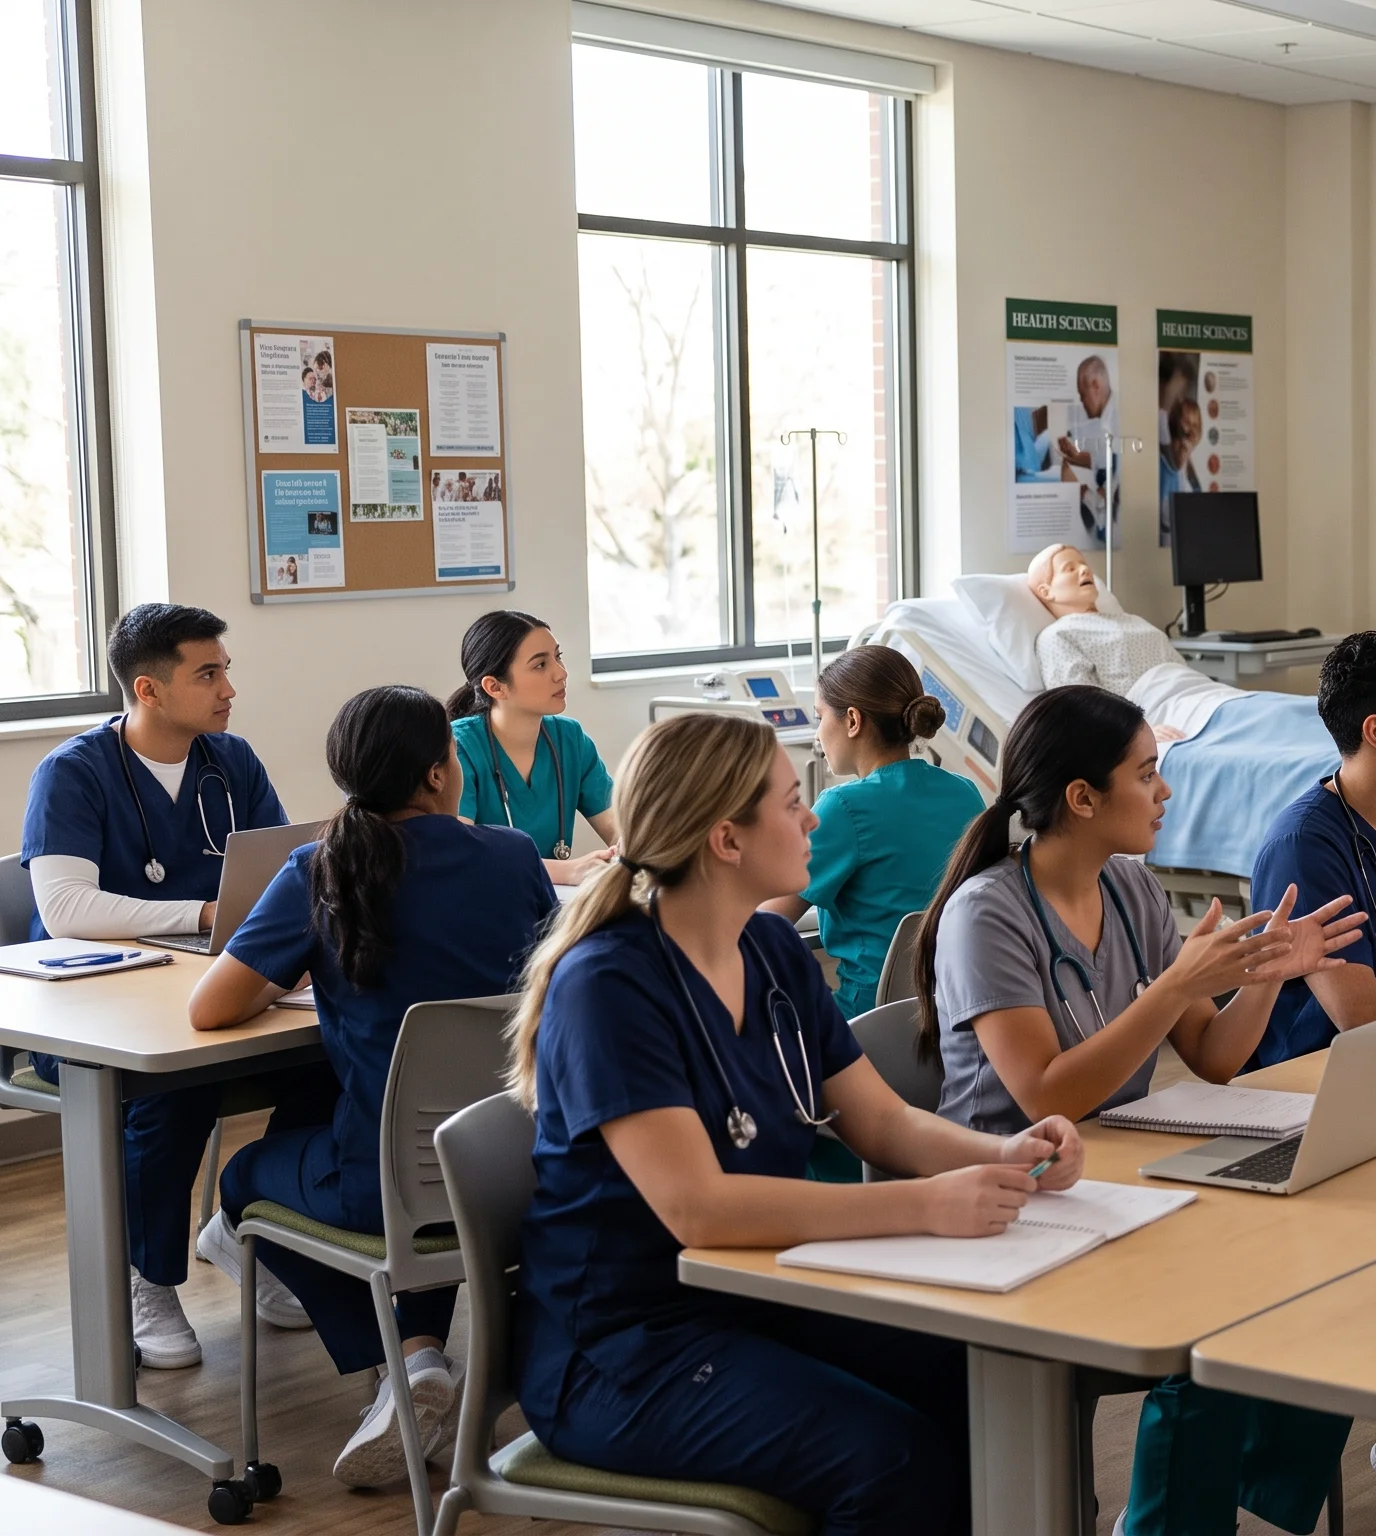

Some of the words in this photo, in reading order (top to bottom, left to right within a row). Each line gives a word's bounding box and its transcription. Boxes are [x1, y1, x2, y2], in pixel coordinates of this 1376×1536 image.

[1012, 312, 1057, 329] HEALTH
[1058, 315, 1112, 332] SCIENCES
[1162, 322, 1201, 338] HEALTH
[1202, 325, 1248, 340] SCIENCES
